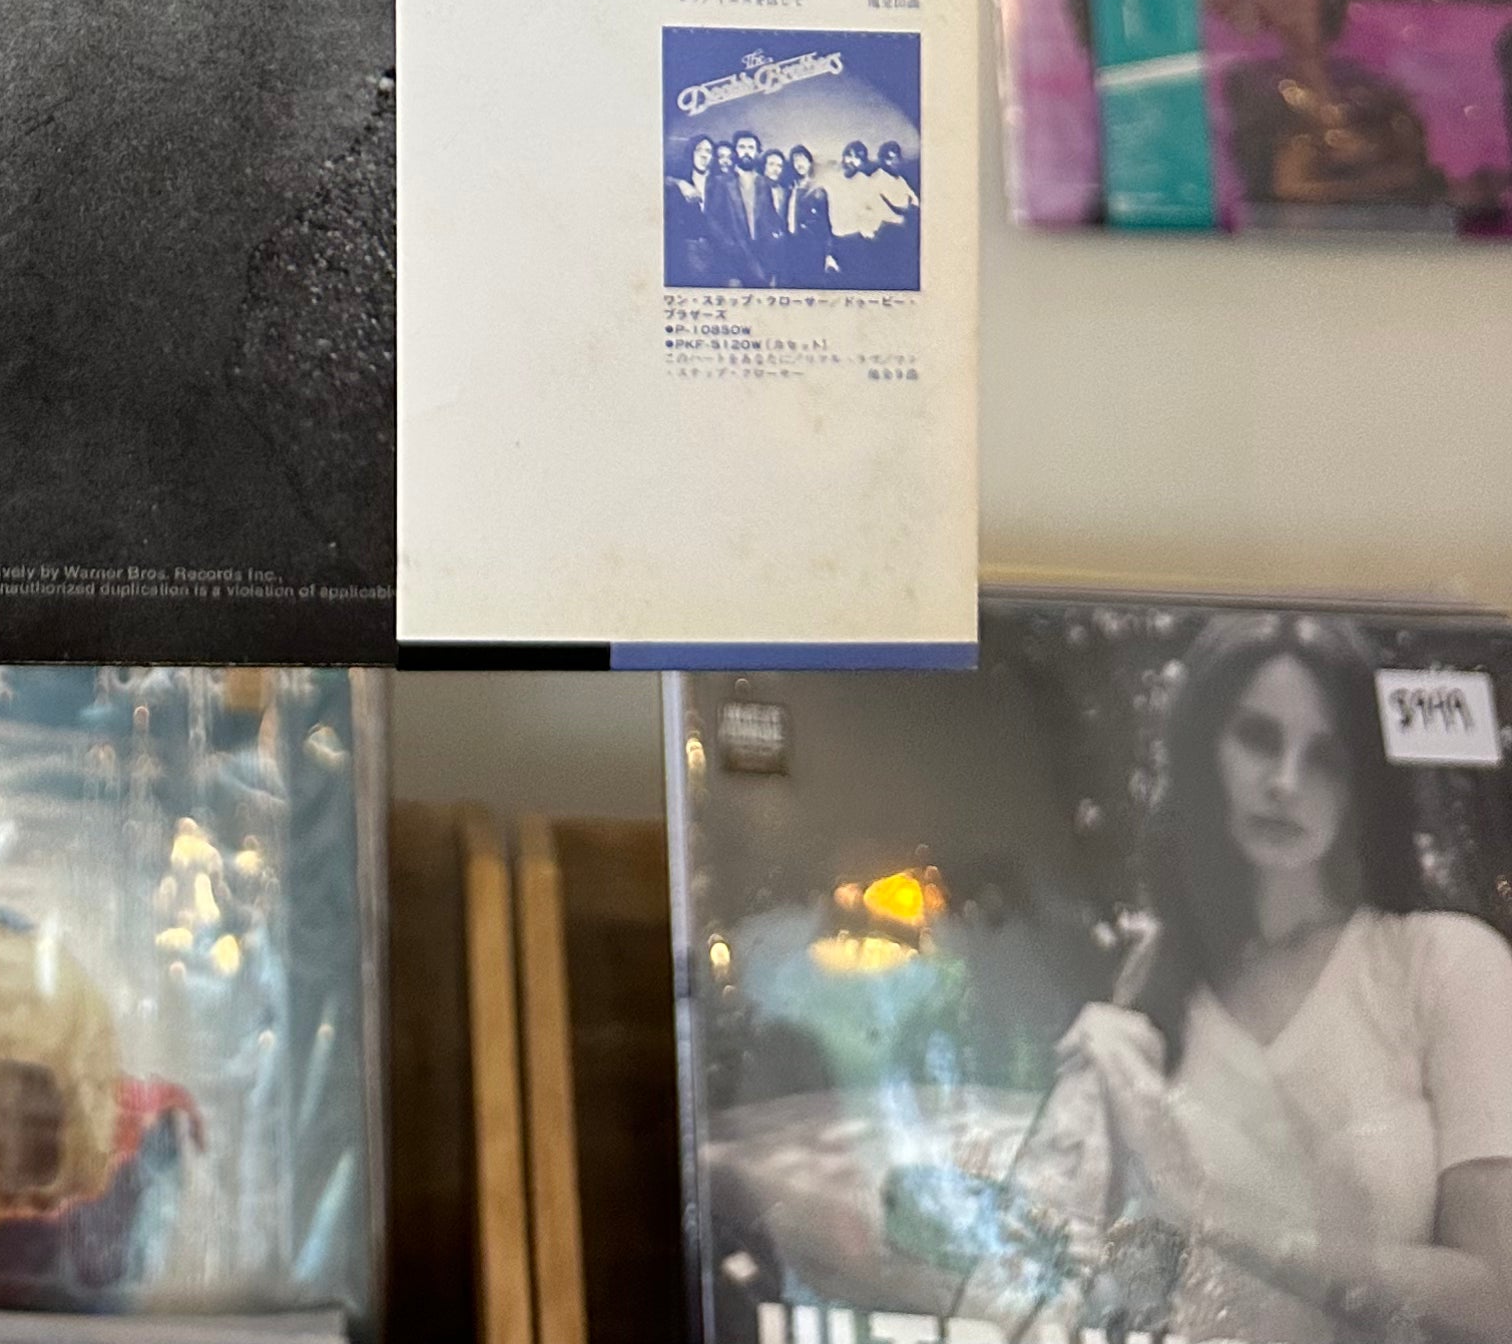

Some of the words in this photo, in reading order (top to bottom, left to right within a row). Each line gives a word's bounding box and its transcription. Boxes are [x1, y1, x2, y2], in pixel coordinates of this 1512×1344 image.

[40, 565, 60, 580] by
[63, 566, 124, 579] Warner
[174, 566, 243, 582] Records
[99, 582, 189, 599] duplication
[194, 585, 208, 597] is
[226, 585, 295, 599] violation
[299, 585, 317, 599] of
